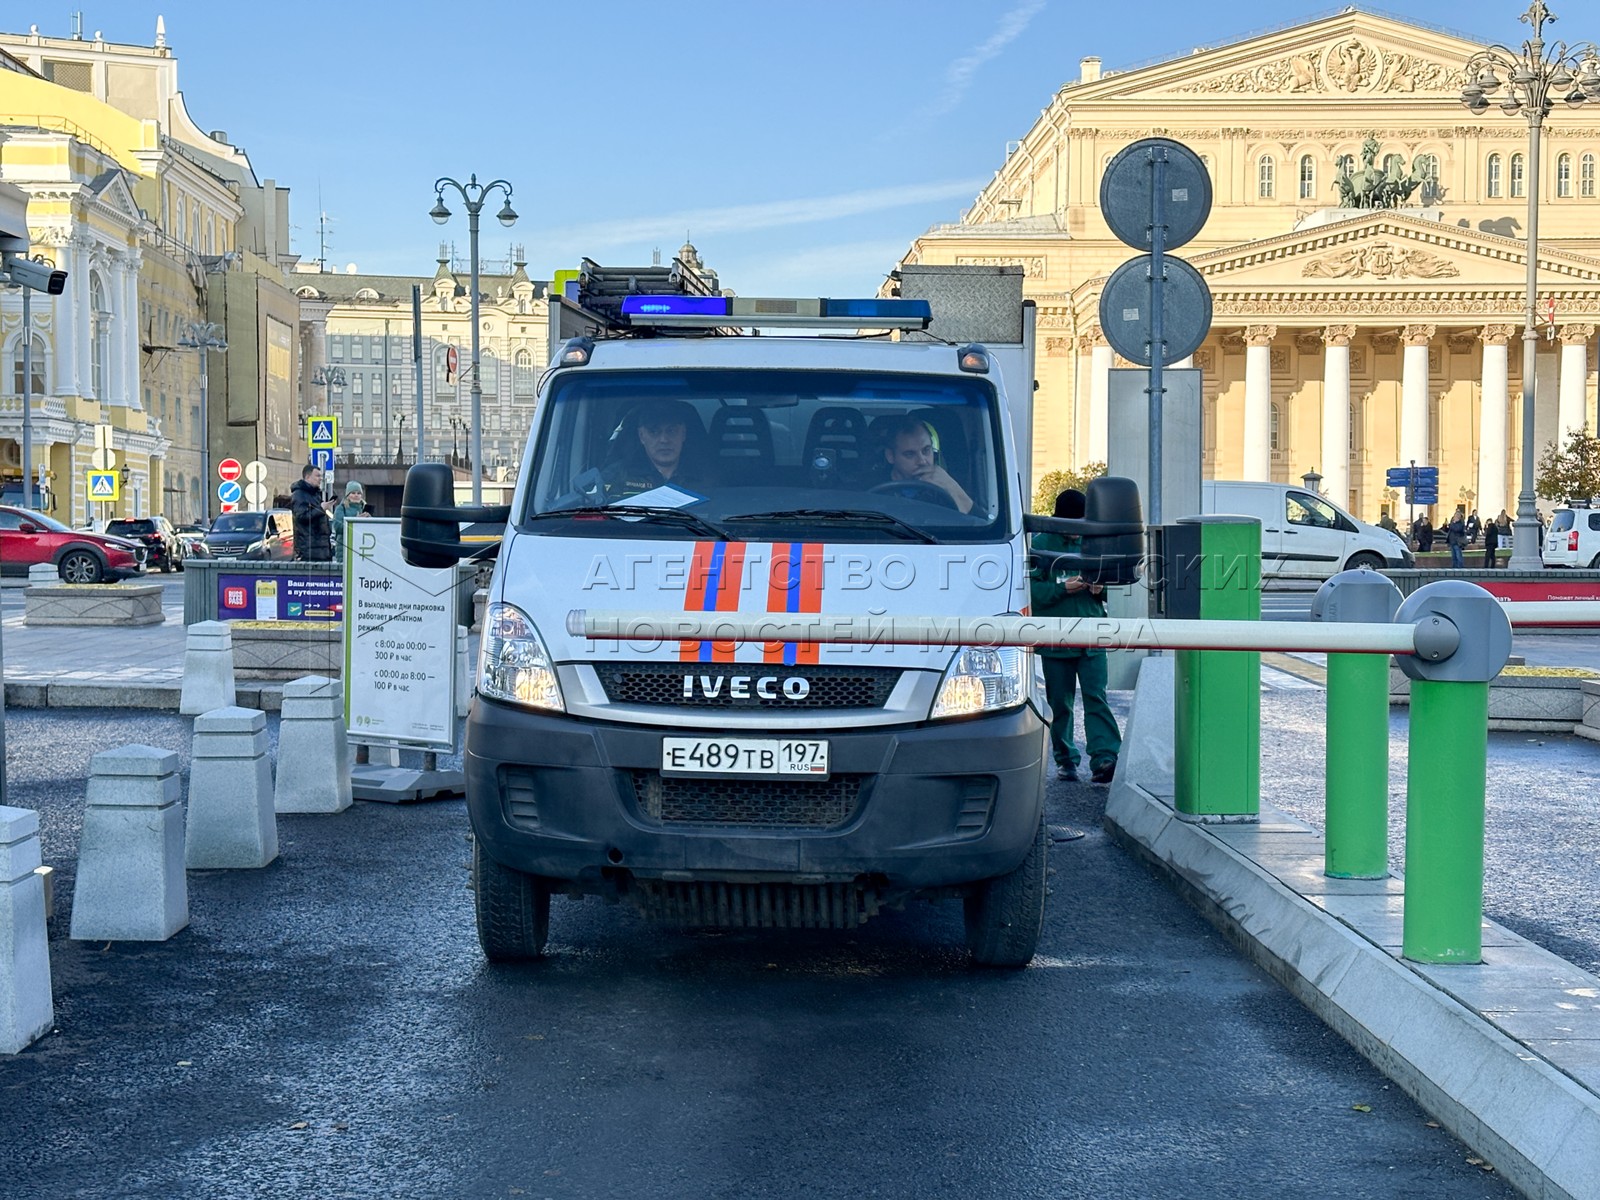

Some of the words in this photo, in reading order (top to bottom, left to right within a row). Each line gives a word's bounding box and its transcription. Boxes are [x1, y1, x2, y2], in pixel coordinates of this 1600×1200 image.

[287, 580, 305, 588] Ваш
[305, 580, 334, 588] личный
[358, 576, 393, 592] Тариф:
[358, 600, 364, 608] В
[364, 601, 398, 610] выходные
[398, 602, 412, 611] дни
[412, 603, 446, 613] парковка
[357, 611, 388, 621] работает
[393, 614, 423, 623] платном
[357, 624, 385, 632] режиме
[380, 640, 396, 649] 8:00
[396, 642, 405, 650] до
[405, 641, 427, 651] 00:00
[374, 651, 388, 660] 300
[379, 669, 400, 679] 00:00
[409, 671, 427, 681] 8:00
[374, 681, 386, 690] 100
[683, 675, 810, 700] IVECO
[782, 743, 820, 763] 197
[789, 763, 810, 771] RUS
